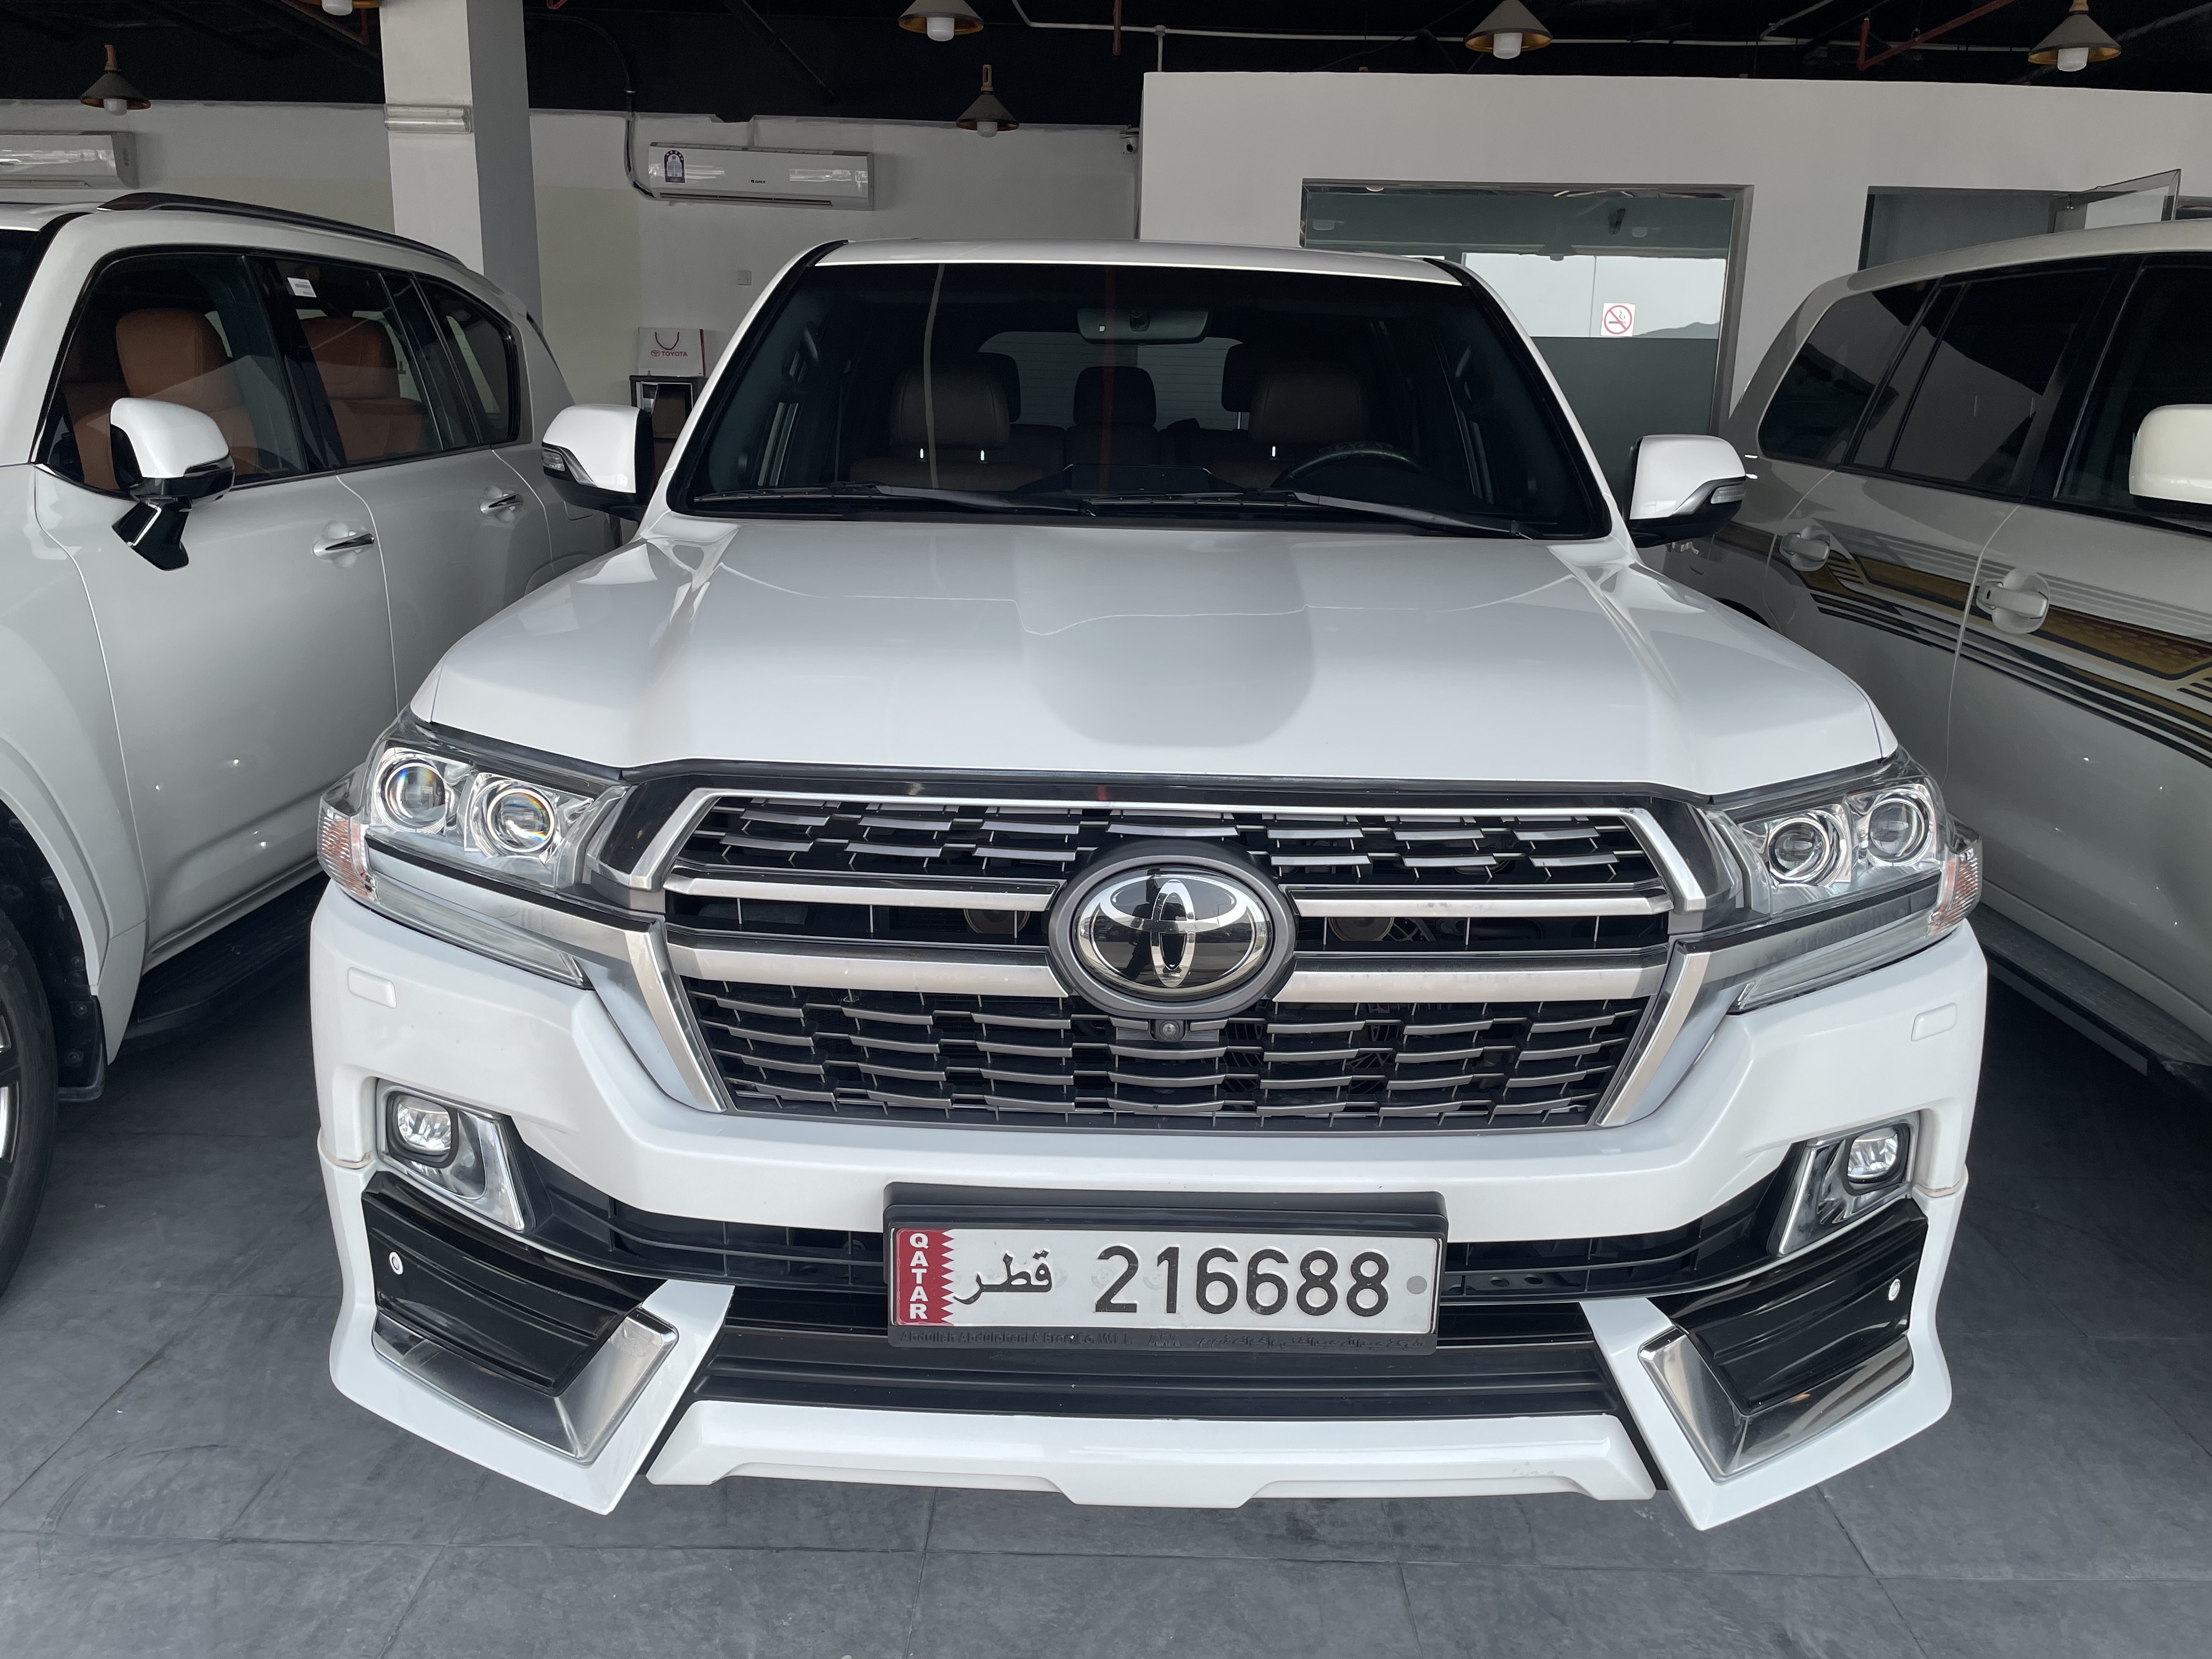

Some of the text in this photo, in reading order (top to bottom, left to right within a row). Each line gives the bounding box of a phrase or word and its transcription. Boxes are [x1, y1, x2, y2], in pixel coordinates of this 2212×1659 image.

[909, 1233, 929, 1320] QATAR
[953, 1249, 1052, 1305] قطر
[1094, 1245, 1390, 1317] 216688
[900, 1331, 955, 1342] Abdullah
[958, 1331, 1029, 1345] Abdulghani
[1032, 1332, 1041, 1343] &
[1076, 1333, 1096, 1344] Co.
